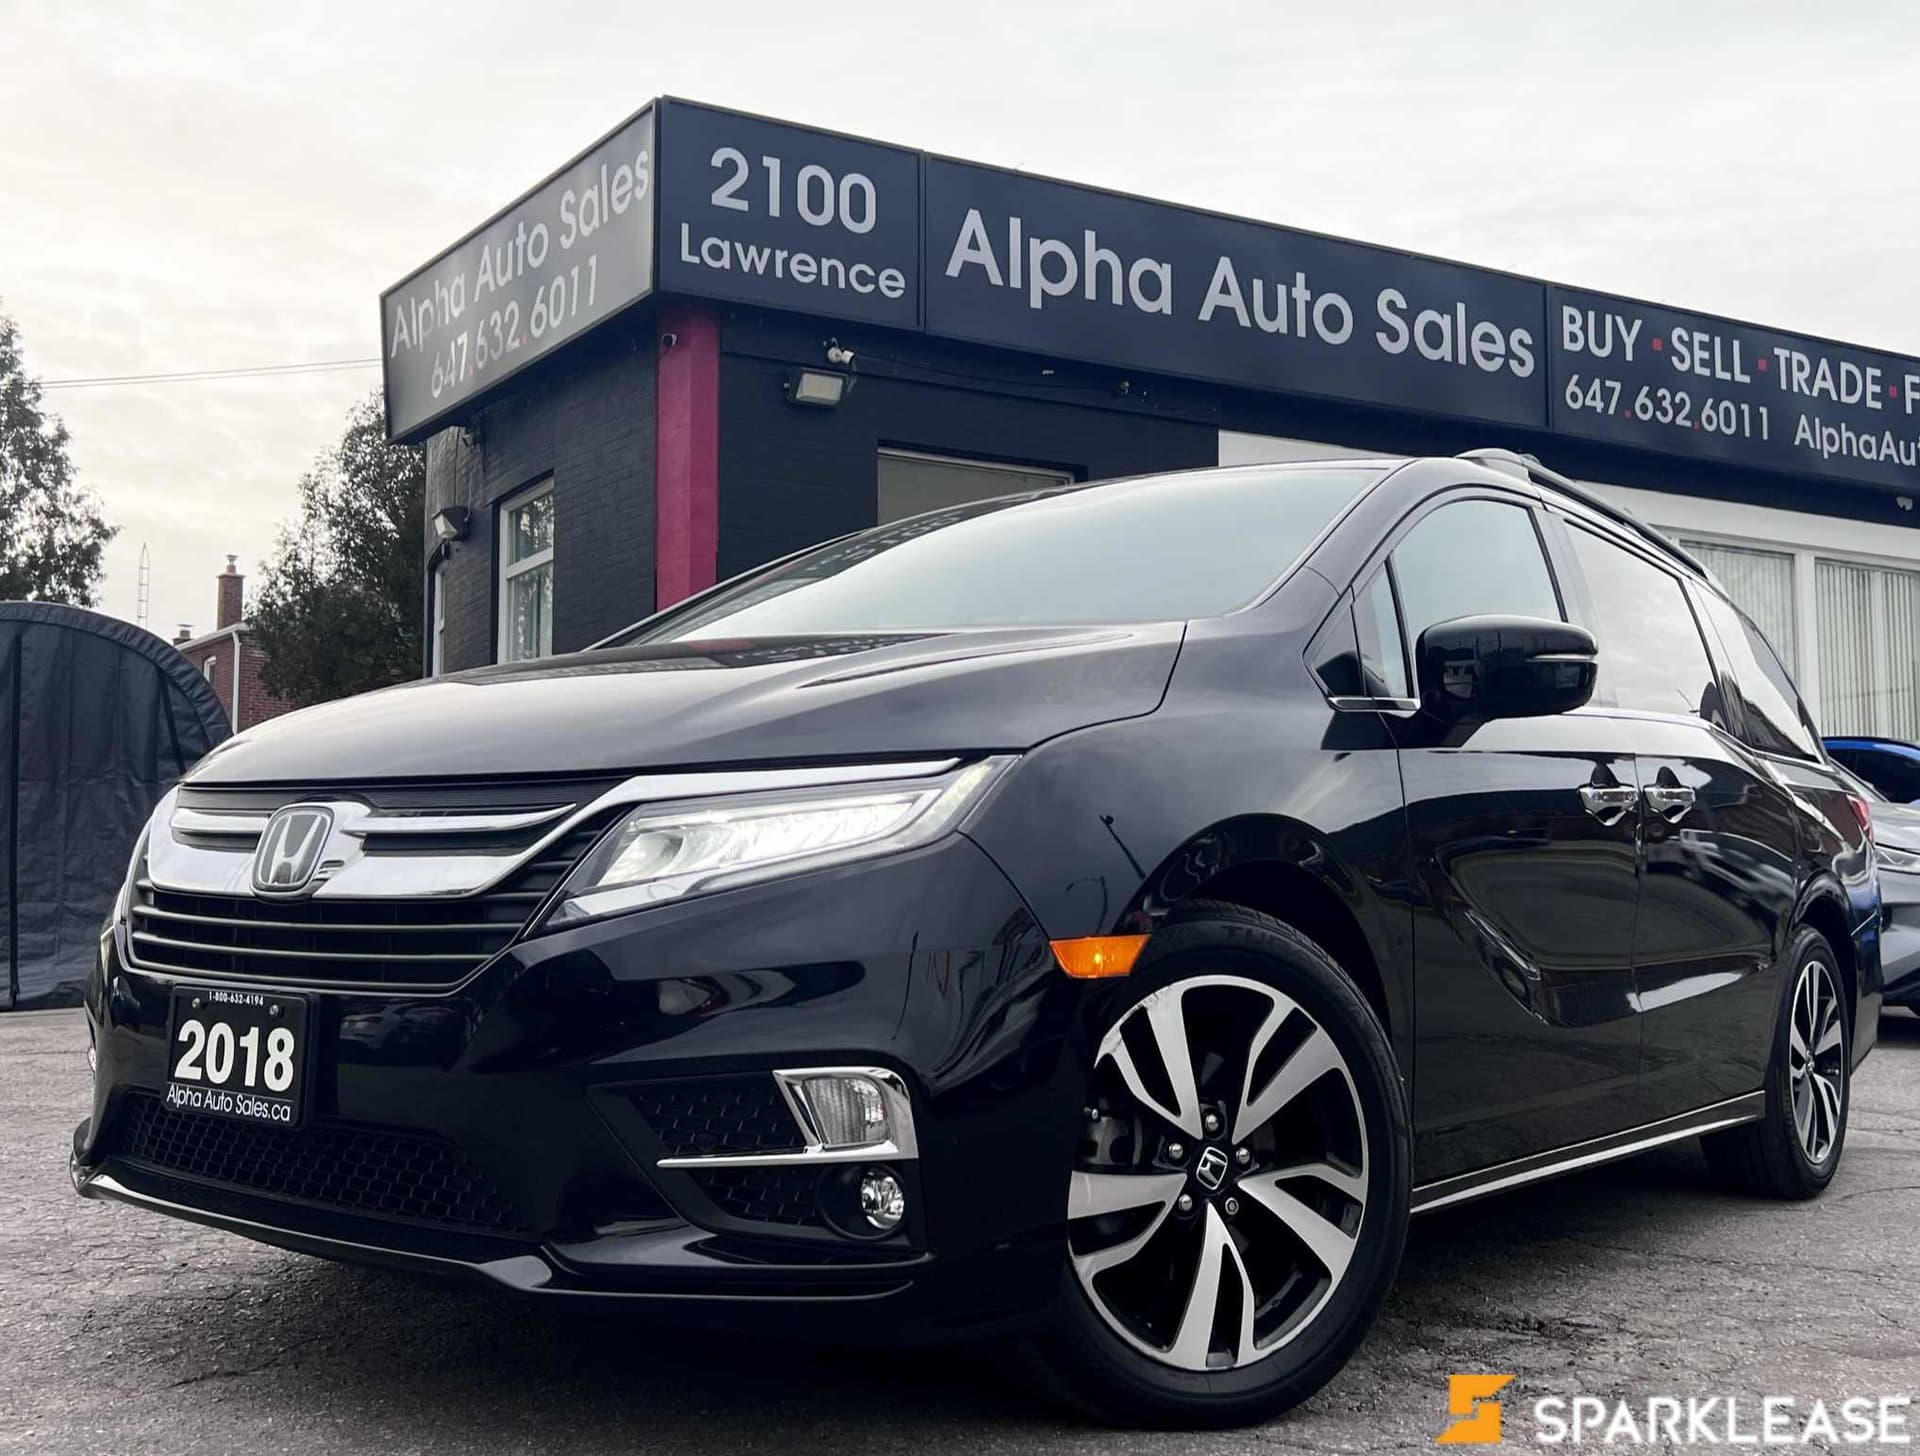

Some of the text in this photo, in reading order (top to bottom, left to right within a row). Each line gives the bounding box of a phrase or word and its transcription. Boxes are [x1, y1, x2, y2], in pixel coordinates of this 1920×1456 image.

[711, 147, 876, 234] 2100
[391, 150, 649, 358] Alpha Auto Sales
[680, 222, 906, 299] Lawrence
[945, 208, 1535, 378] Alpha Auto Sales
[1562, 305, 1643, 361] BUY
[1670, 327, 1750, 384] SELL
[1773, 347, 1882, 409] TRADE
[1794, 414, 1920, 467] AlphaAu
[209, 991, 264, 1006] 1-800-632-4194
[174, 1019, 295, 1092] 2018
[167, 1084, 291, 1122] Alpha Auto Sales.ca
